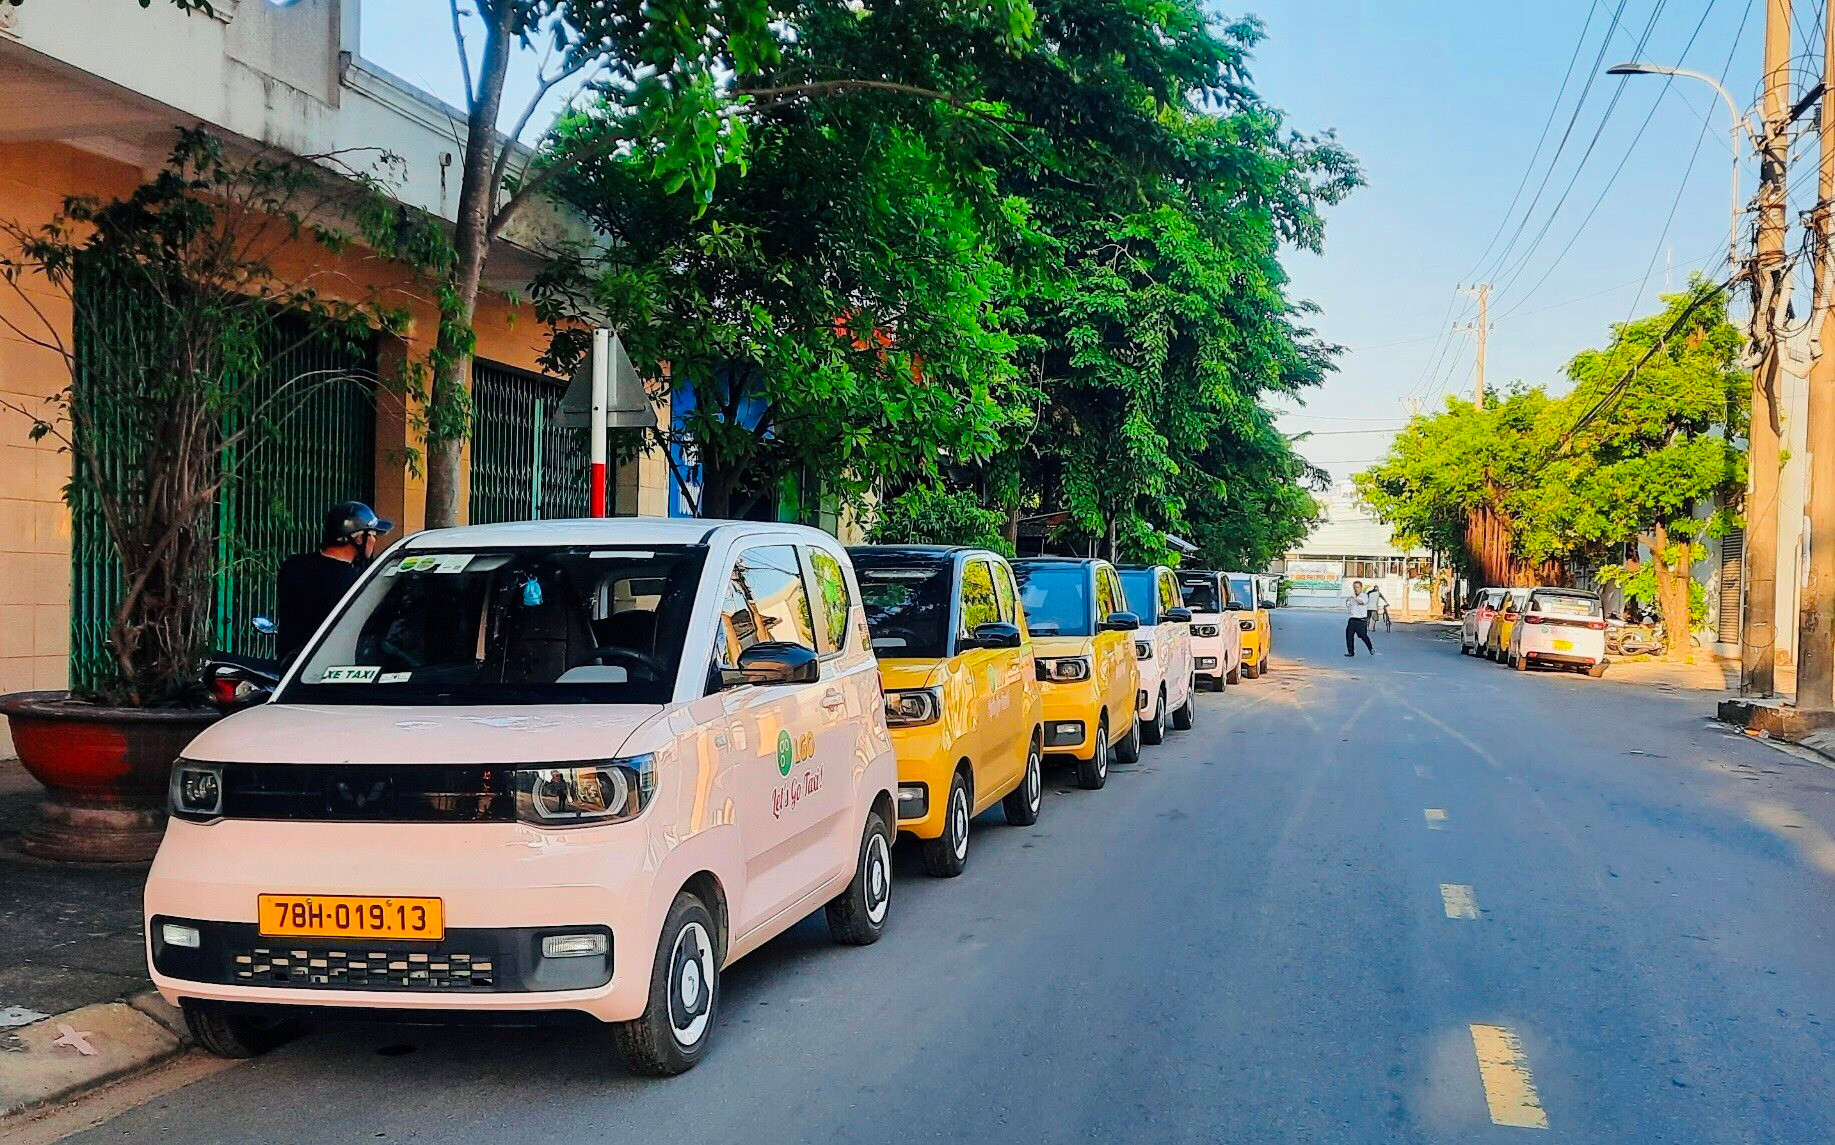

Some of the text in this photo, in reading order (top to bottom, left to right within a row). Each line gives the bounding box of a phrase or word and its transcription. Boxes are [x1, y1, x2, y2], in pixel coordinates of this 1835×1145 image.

[322, 670, 344, 679] XE
[345, 670, 376, 679] TAXI
[791, 777, 802, 811] Go
[274, 902, 427, 932] 78H-019.13
